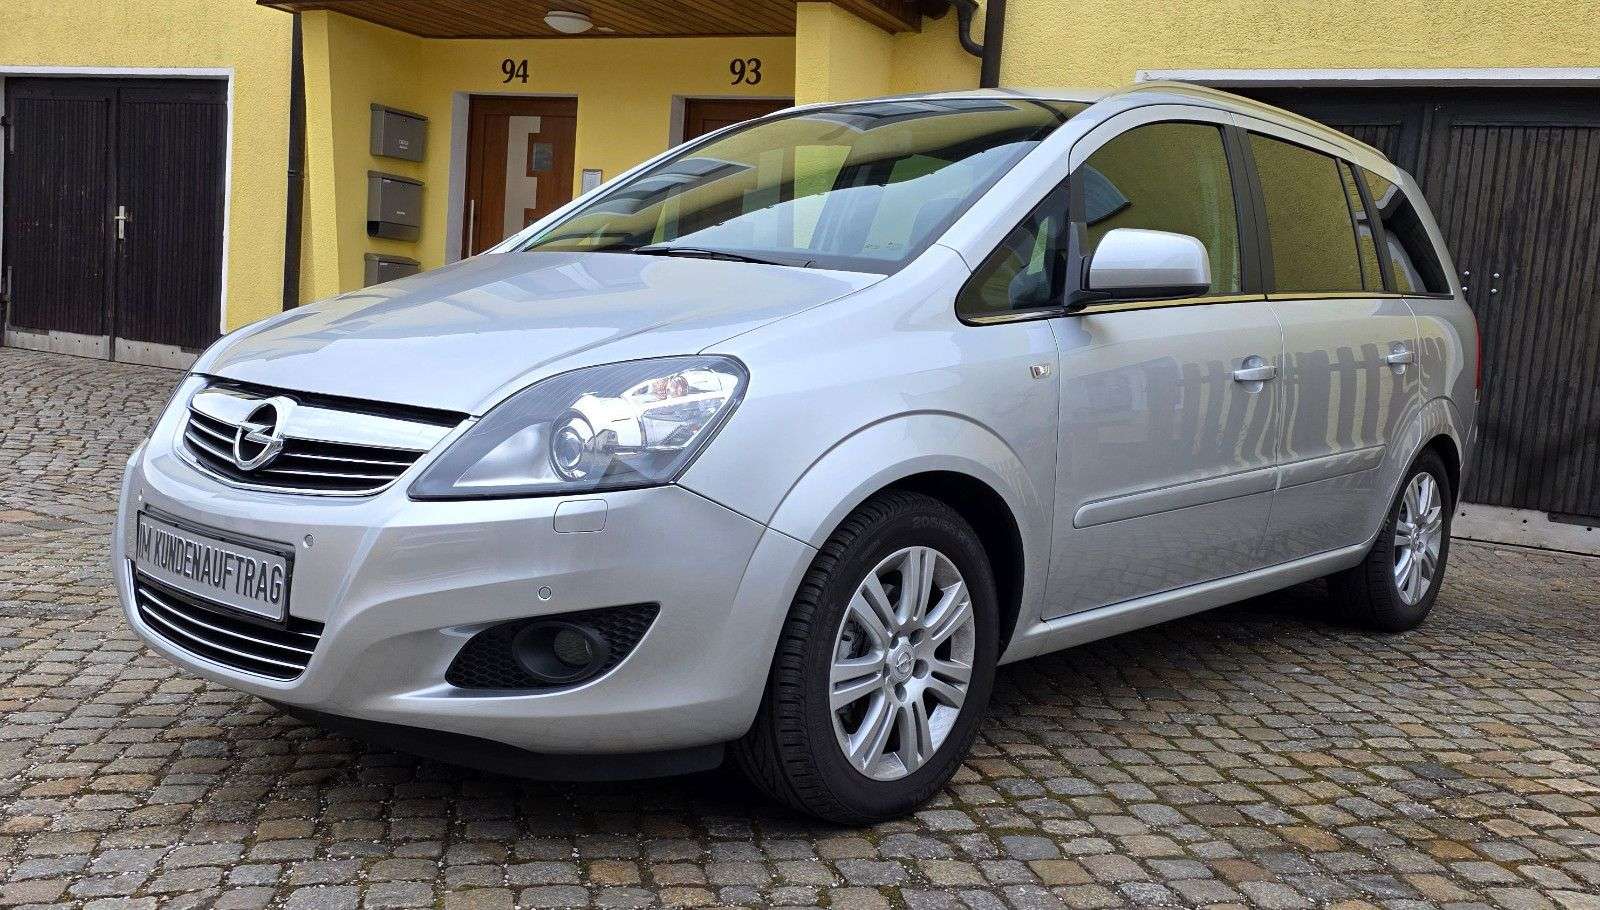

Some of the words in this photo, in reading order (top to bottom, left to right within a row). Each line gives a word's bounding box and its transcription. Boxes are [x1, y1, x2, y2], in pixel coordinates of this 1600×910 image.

[501, 58, 530, 84] 94
[729, 57, 762, 86] 93
[136, 522, 152, 562] IM
[154, 529, 283, 604] KUNDENAUFTRAG
